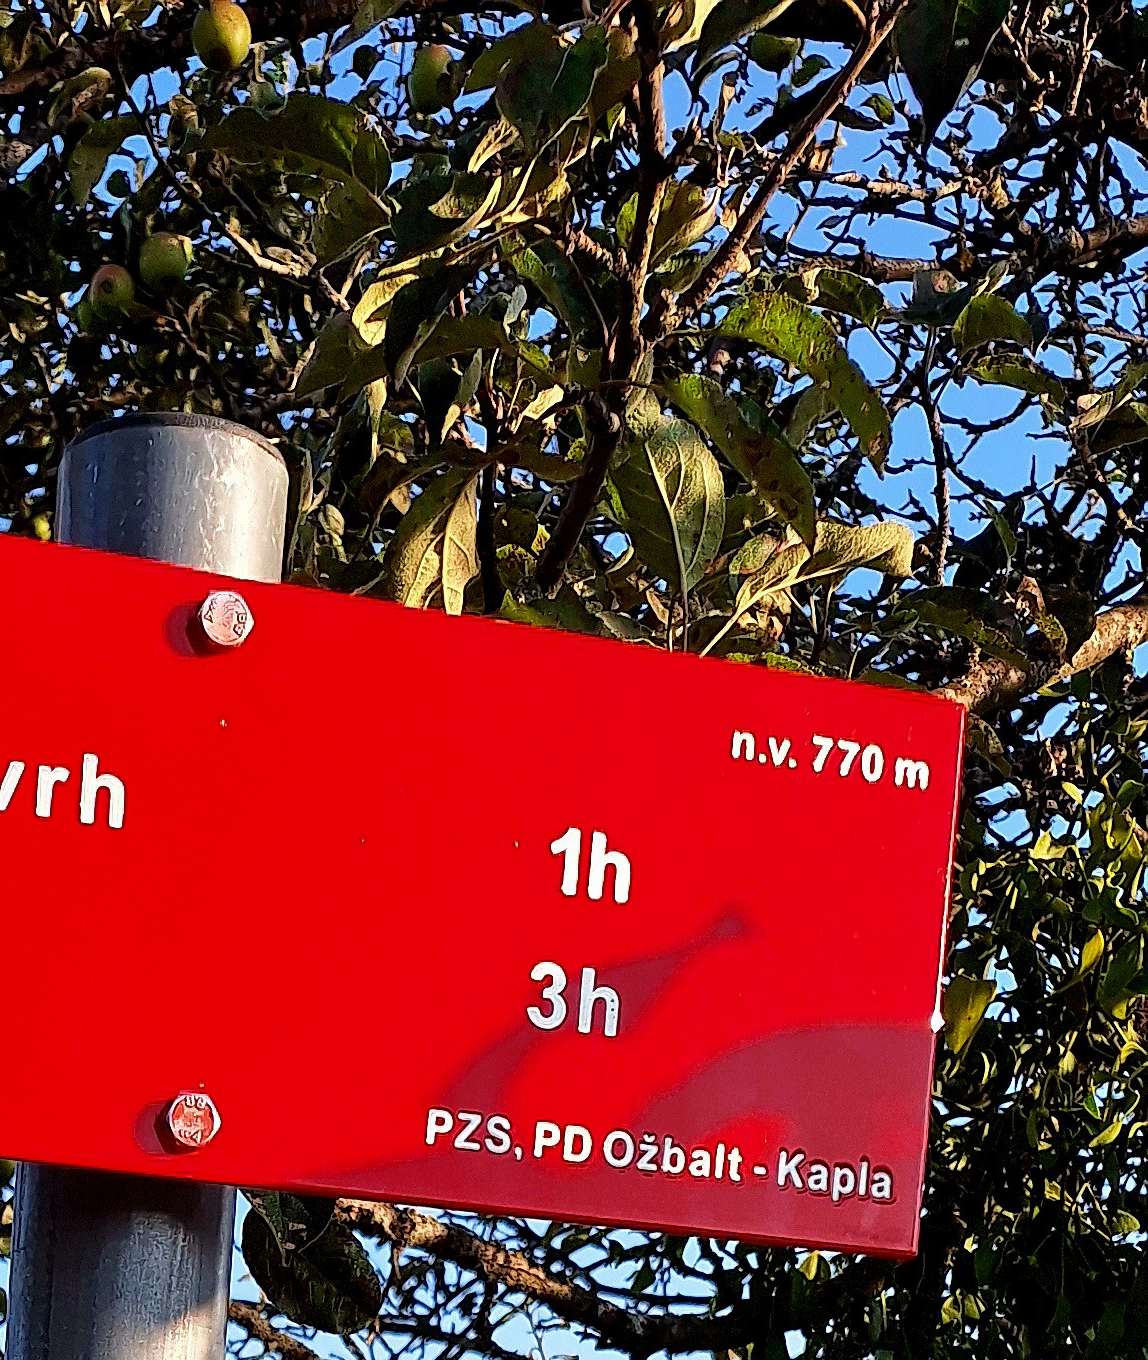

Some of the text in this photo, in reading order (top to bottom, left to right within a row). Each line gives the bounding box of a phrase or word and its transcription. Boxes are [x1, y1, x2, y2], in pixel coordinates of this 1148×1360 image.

[731, 729, 930, 791] n.v. 770 m
[550, 827, 631, 904] 1h
[526, 961, 620, 1037] 3h
[425, 1108, 892, 1202] PZS, PD Ožbalt - Kapla
